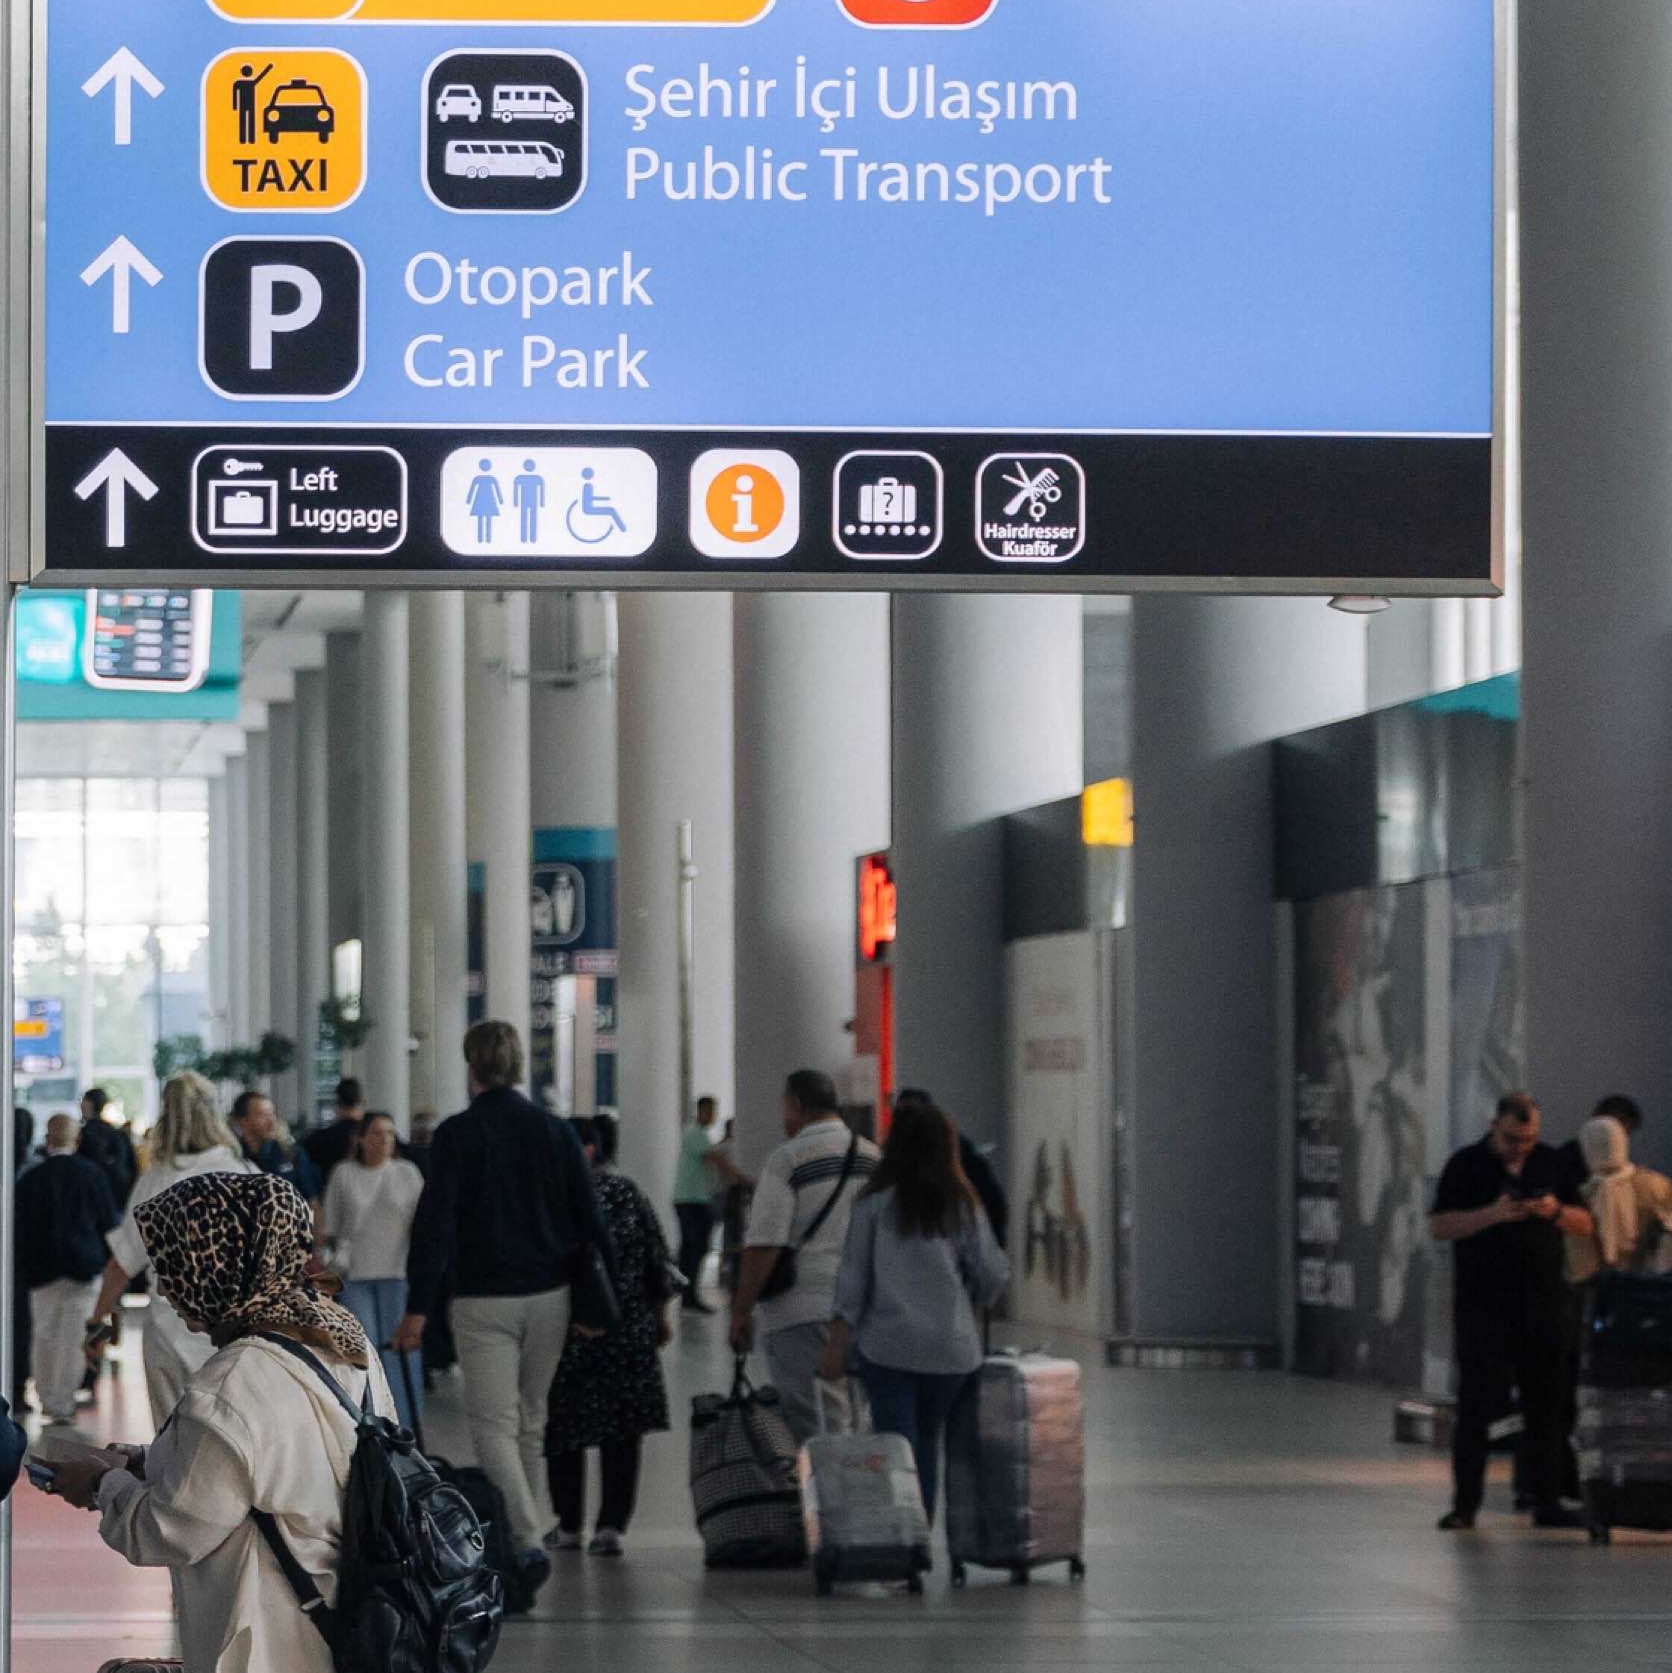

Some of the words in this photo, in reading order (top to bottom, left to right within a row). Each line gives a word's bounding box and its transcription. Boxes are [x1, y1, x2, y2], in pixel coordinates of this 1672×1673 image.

[624, 62, 777, 131] Şehir
[795, 55, 857, 133] İçi
[878, 64, 1077, 134] Ulaşım
[232, 158, 327, 192] TAXI
[626, 144, 807, 201] Public
[822, 149, 1113, 216] Transport
[404, 250, 654, 319] Otopark
[249, 264, 323, 370] P
[403, 334, 504, 388] Car
[522, 333, 650, 389] Park
[290, 466, 338, 491] Left
[290, 503, 399, 534] Luggage
[983, 522, 1077, 540] Hairdresser
[1002, 540, 1059, 557] Kuaför
